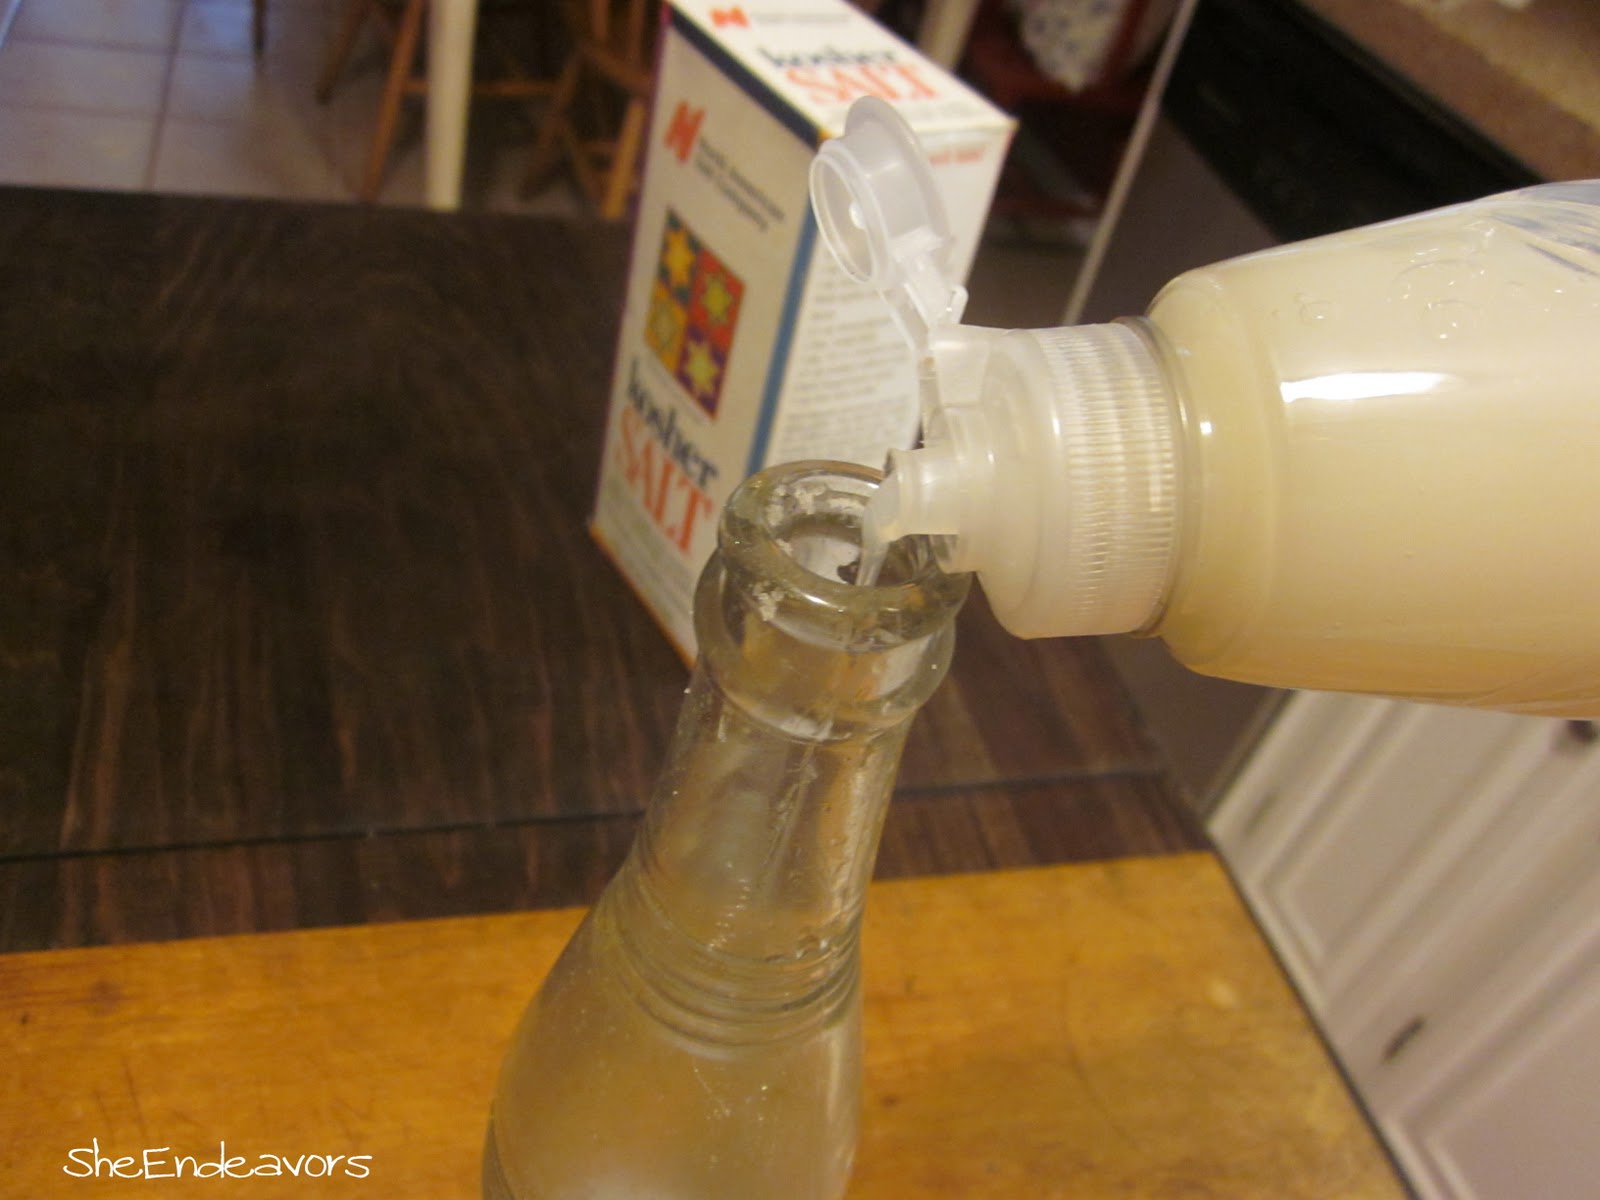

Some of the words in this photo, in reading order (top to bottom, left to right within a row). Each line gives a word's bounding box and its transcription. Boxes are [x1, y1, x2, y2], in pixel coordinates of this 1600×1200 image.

[785, 63, 940, 105] SALT
[612, 404, 716, 556] SALT
[626, 355, 720, 488] kosher
